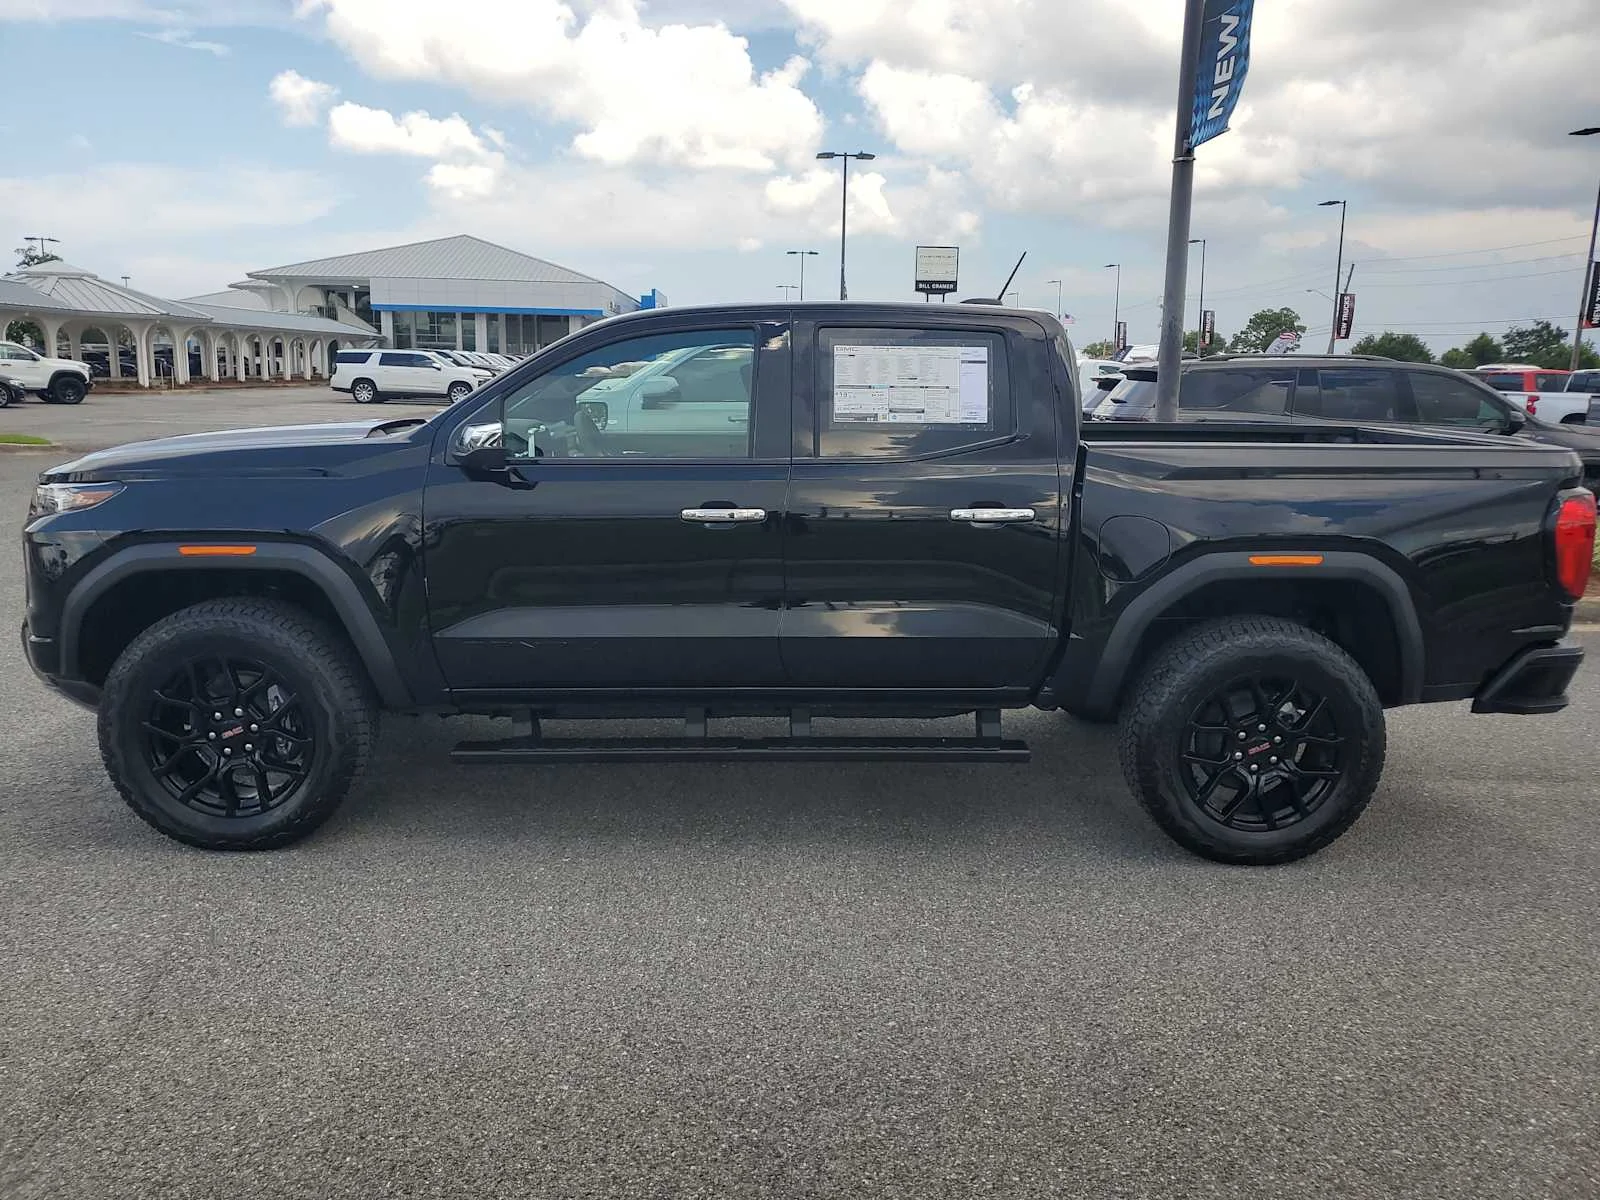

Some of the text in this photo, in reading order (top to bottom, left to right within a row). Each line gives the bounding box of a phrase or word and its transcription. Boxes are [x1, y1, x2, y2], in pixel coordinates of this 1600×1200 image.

[1207, 15, 1240, 120] NEW
[1342, 295, 1350, 321] TRUCKS
[221, 725, 244, 739] GMC
[1248, 742, 1271, 755] GMC
